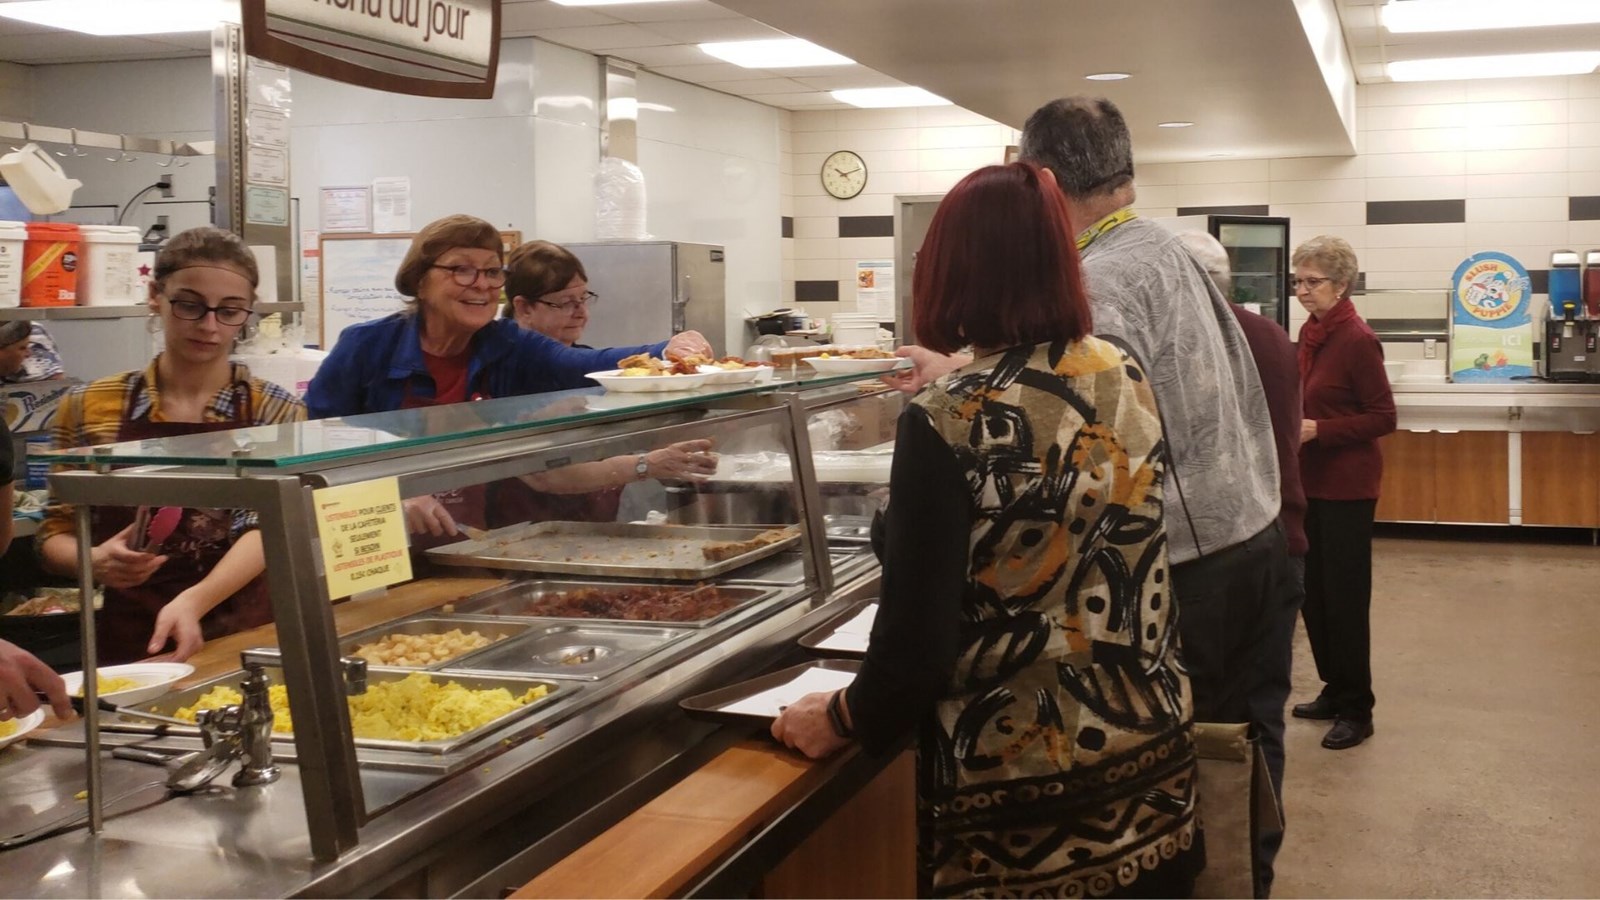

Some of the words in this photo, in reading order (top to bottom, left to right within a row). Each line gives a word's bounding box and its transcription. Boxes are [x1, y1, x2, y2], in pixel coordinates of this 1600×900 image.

[423, 0, 470, 42] jour
[1465, 263, 1499, 282] SLUSH
[1472, 303, 1513, 318] PUPPIE
[359, 507, 374, 515] POUR
[375, 503, 396, 513] CLIENTS
[341, 524, 349, 532] DE
[349, 529, 381, 543] SEULEMENT
[360, 543, 380, 552] BESOIN
[366, 564, 390, 576] CHAQUE
